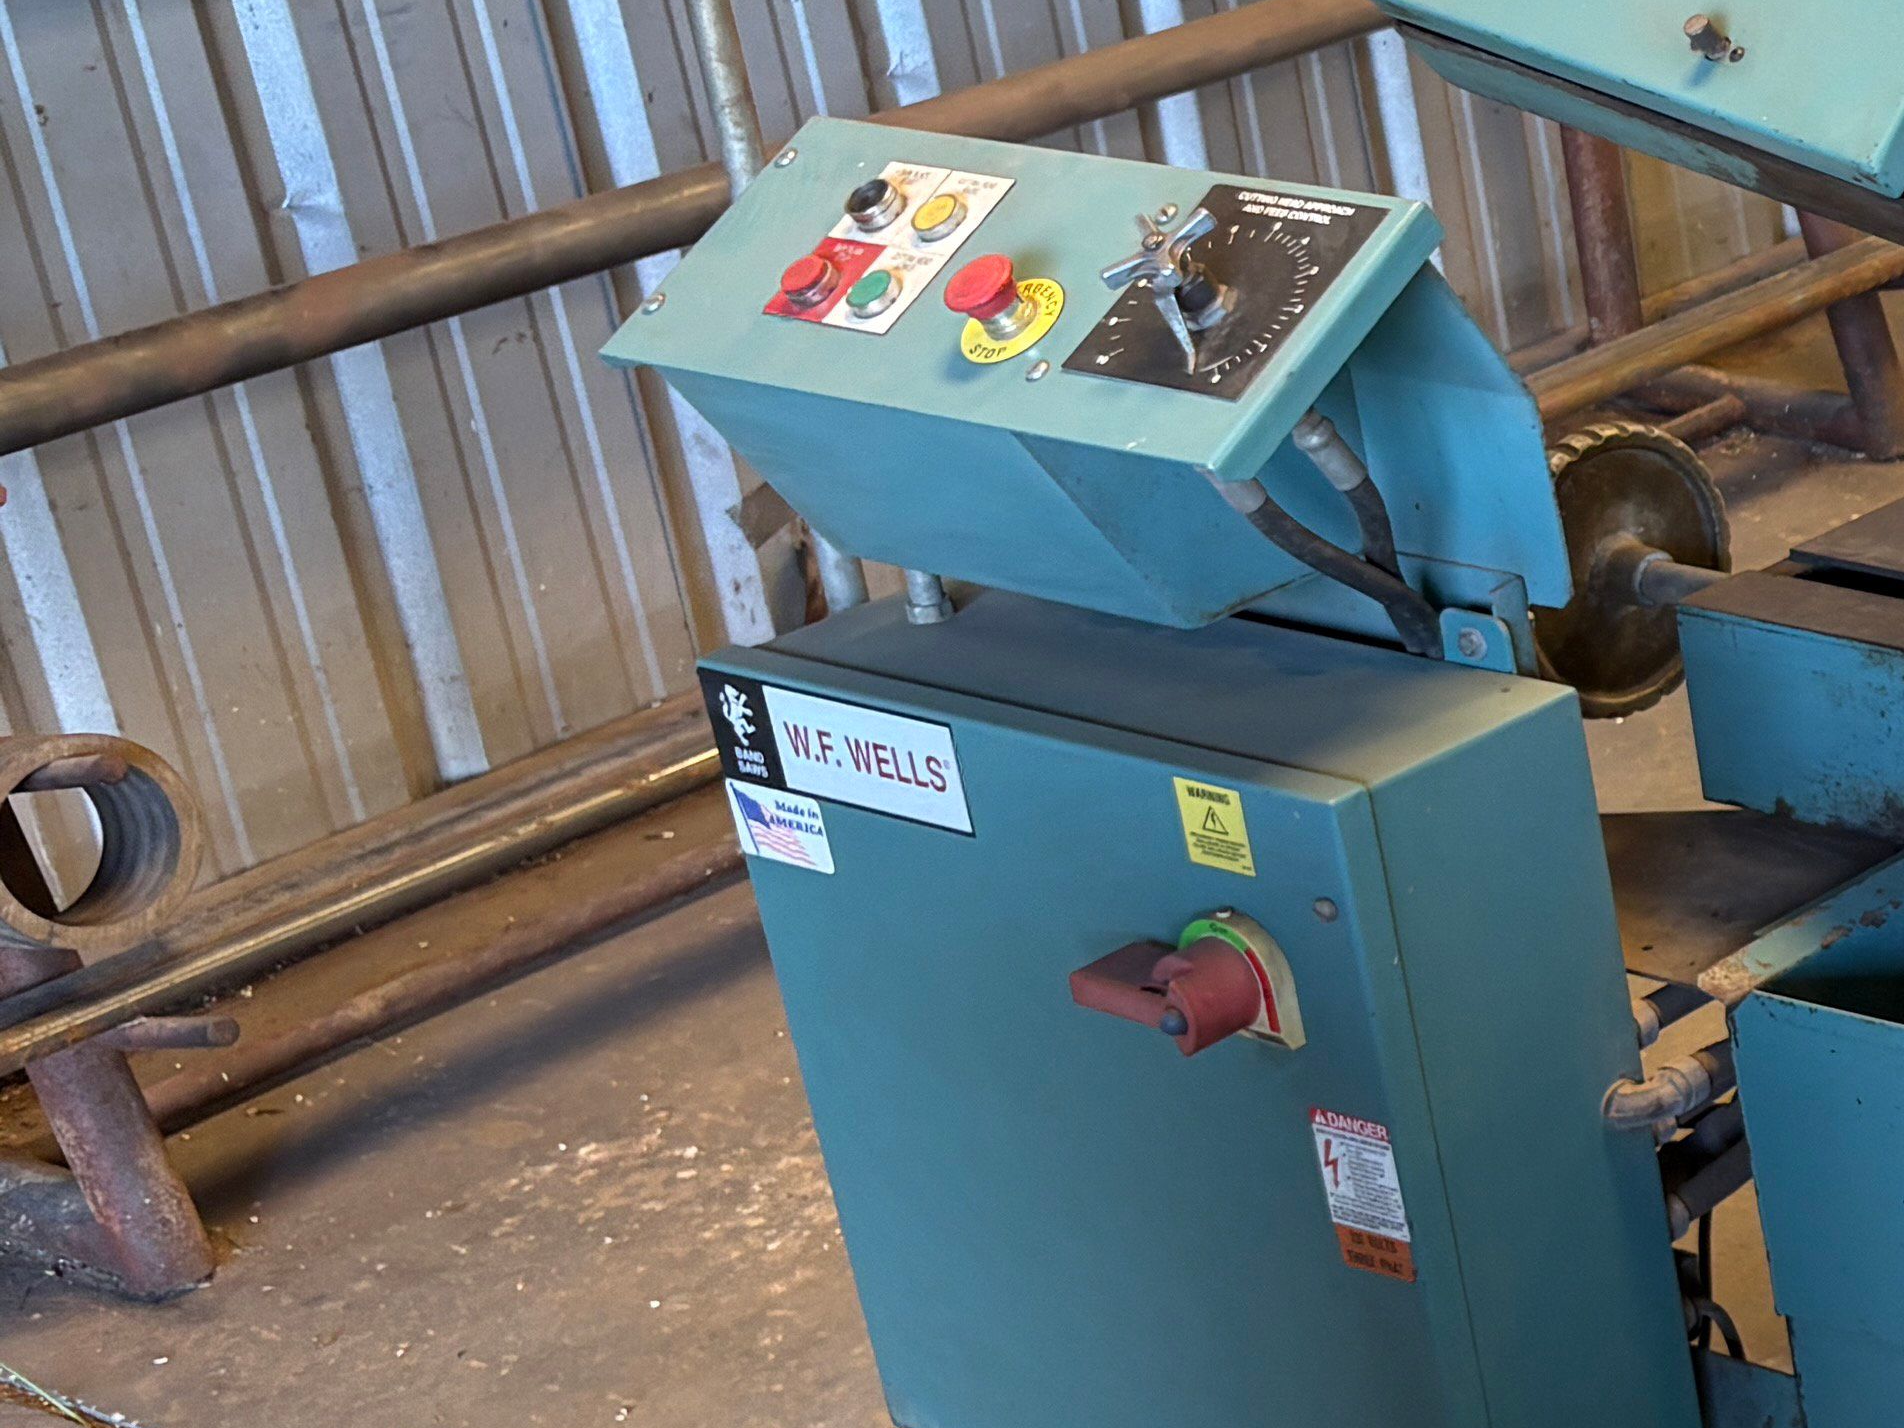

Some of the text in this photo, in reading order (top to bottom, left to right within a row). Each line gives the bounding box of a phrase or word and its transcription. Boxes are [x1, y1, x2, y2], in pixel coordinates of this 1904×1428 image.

[969, 344, 1007, 359] STOP
[734, 746, 765, 764] BAND
[783, 720, 947, 792] W.F. WELLS
[737, 759, 769, 779] SAWS
[775, 800, 820, 819] Made in
[769, 814, 824, 837] AMERICA
[1327, 1112, 1389, 1141] DANGER
